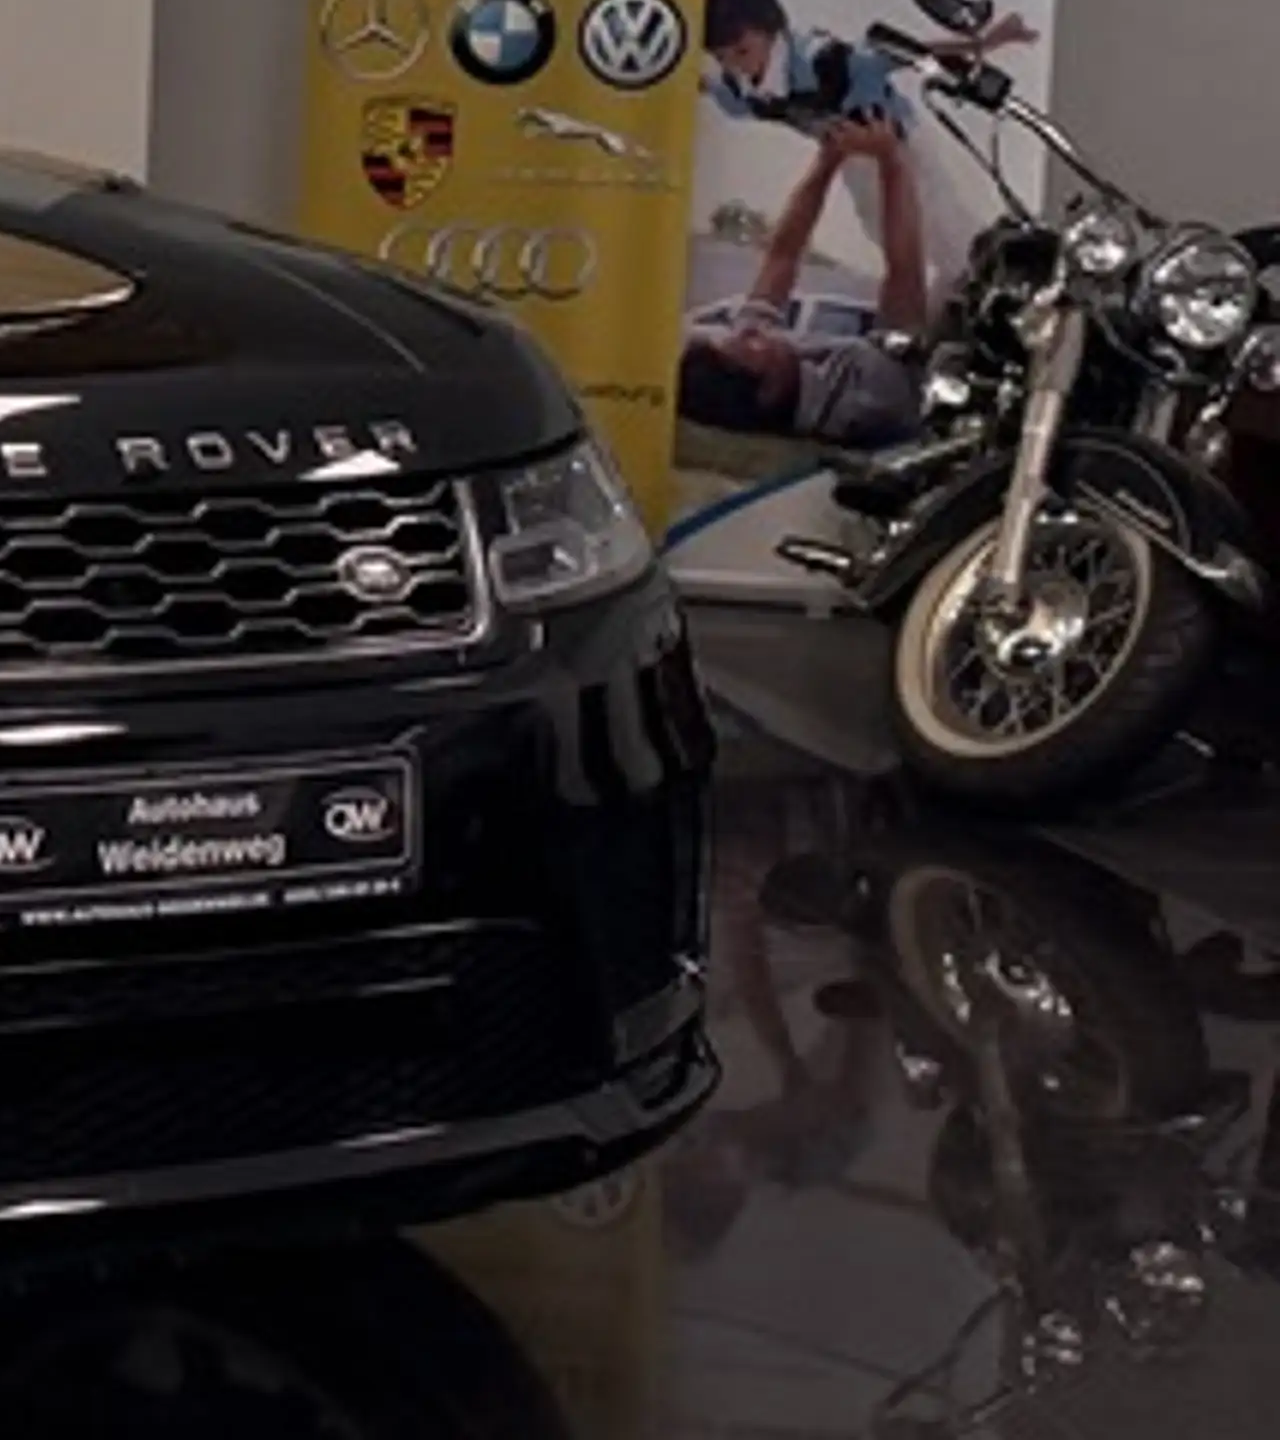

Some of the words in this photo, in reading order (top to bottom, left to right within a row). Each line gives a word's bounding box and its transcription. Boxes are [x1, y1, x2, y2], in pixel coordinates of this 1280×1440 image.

[117, 419, 419, 474] ROVER
[126, 791, 261, 825] Autohaus
[97, 832, 287, 875] Weidenweg
